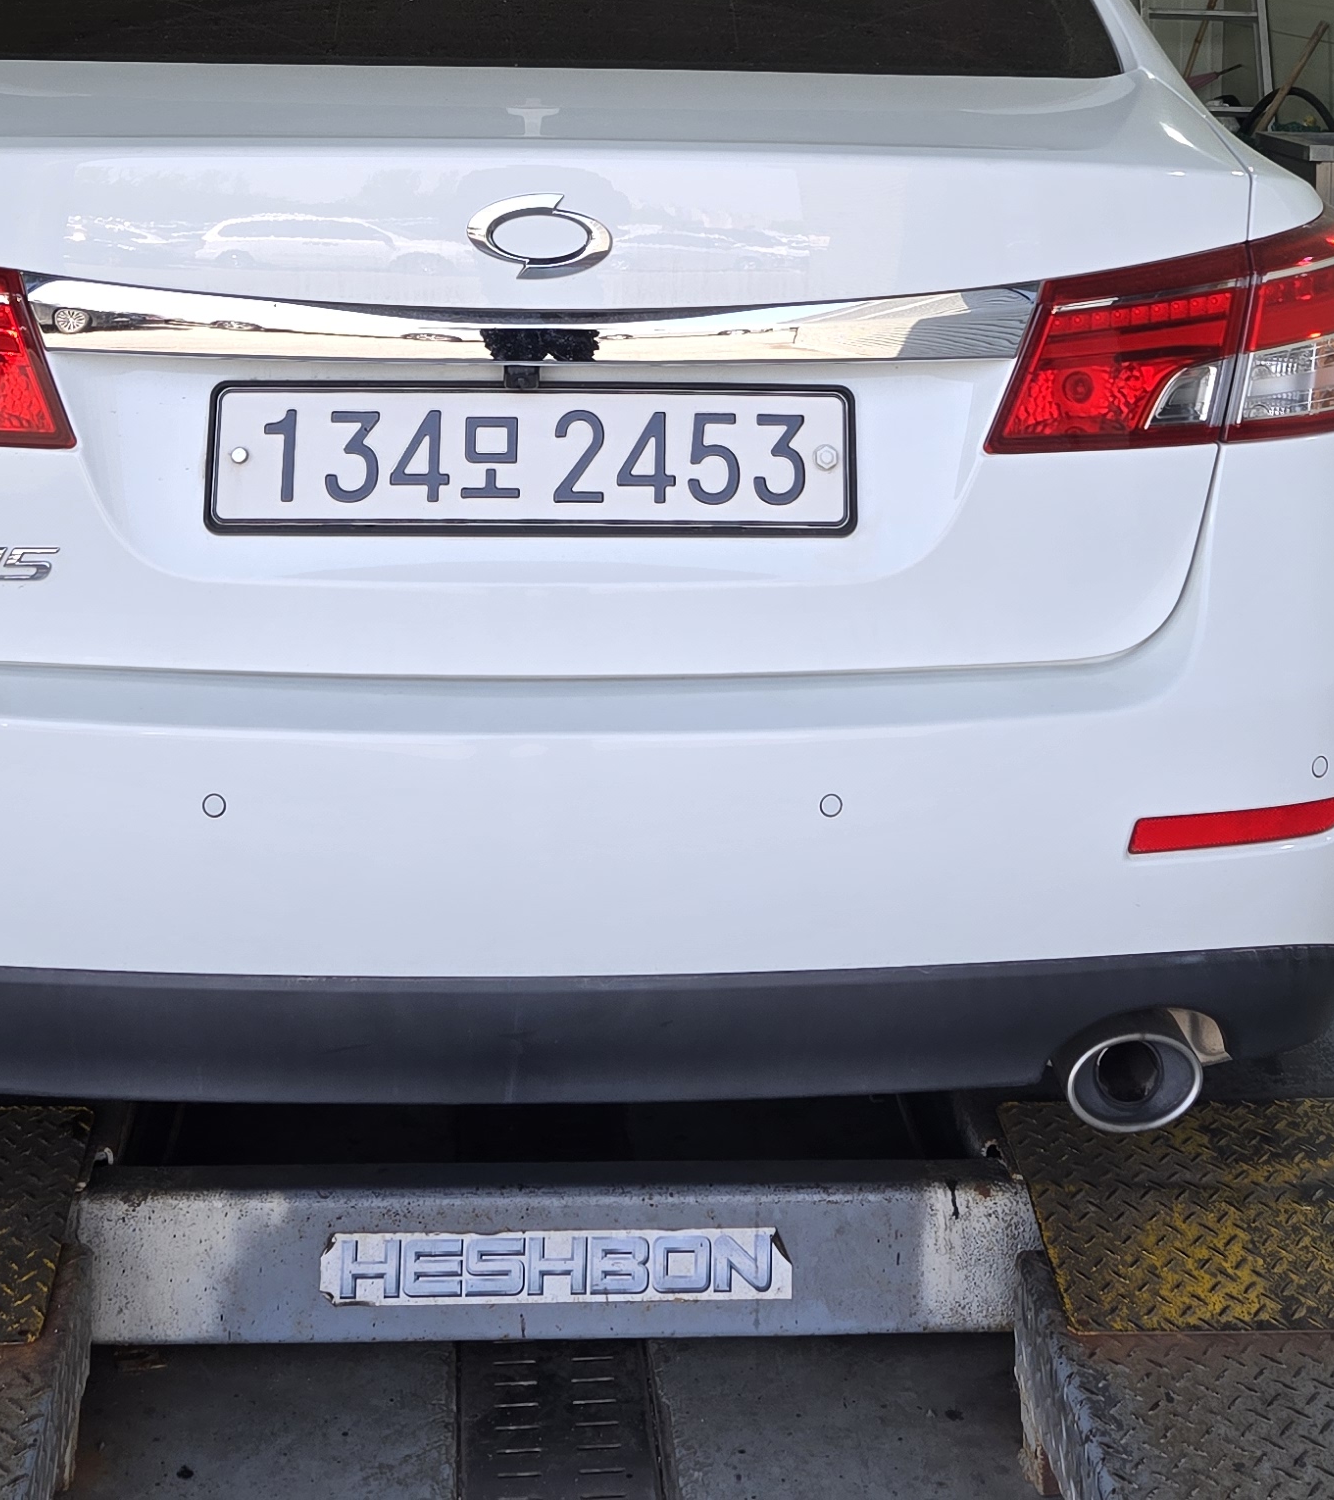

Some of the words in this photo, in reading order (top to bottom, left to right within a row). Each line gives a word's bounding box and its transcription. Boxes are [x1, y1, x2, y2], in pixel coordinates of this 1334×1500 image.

[264, 409, 520, 503] 134모
[554, 410, 805, 505] 2453
[339, 1233, 774, 1299] HESHBON
